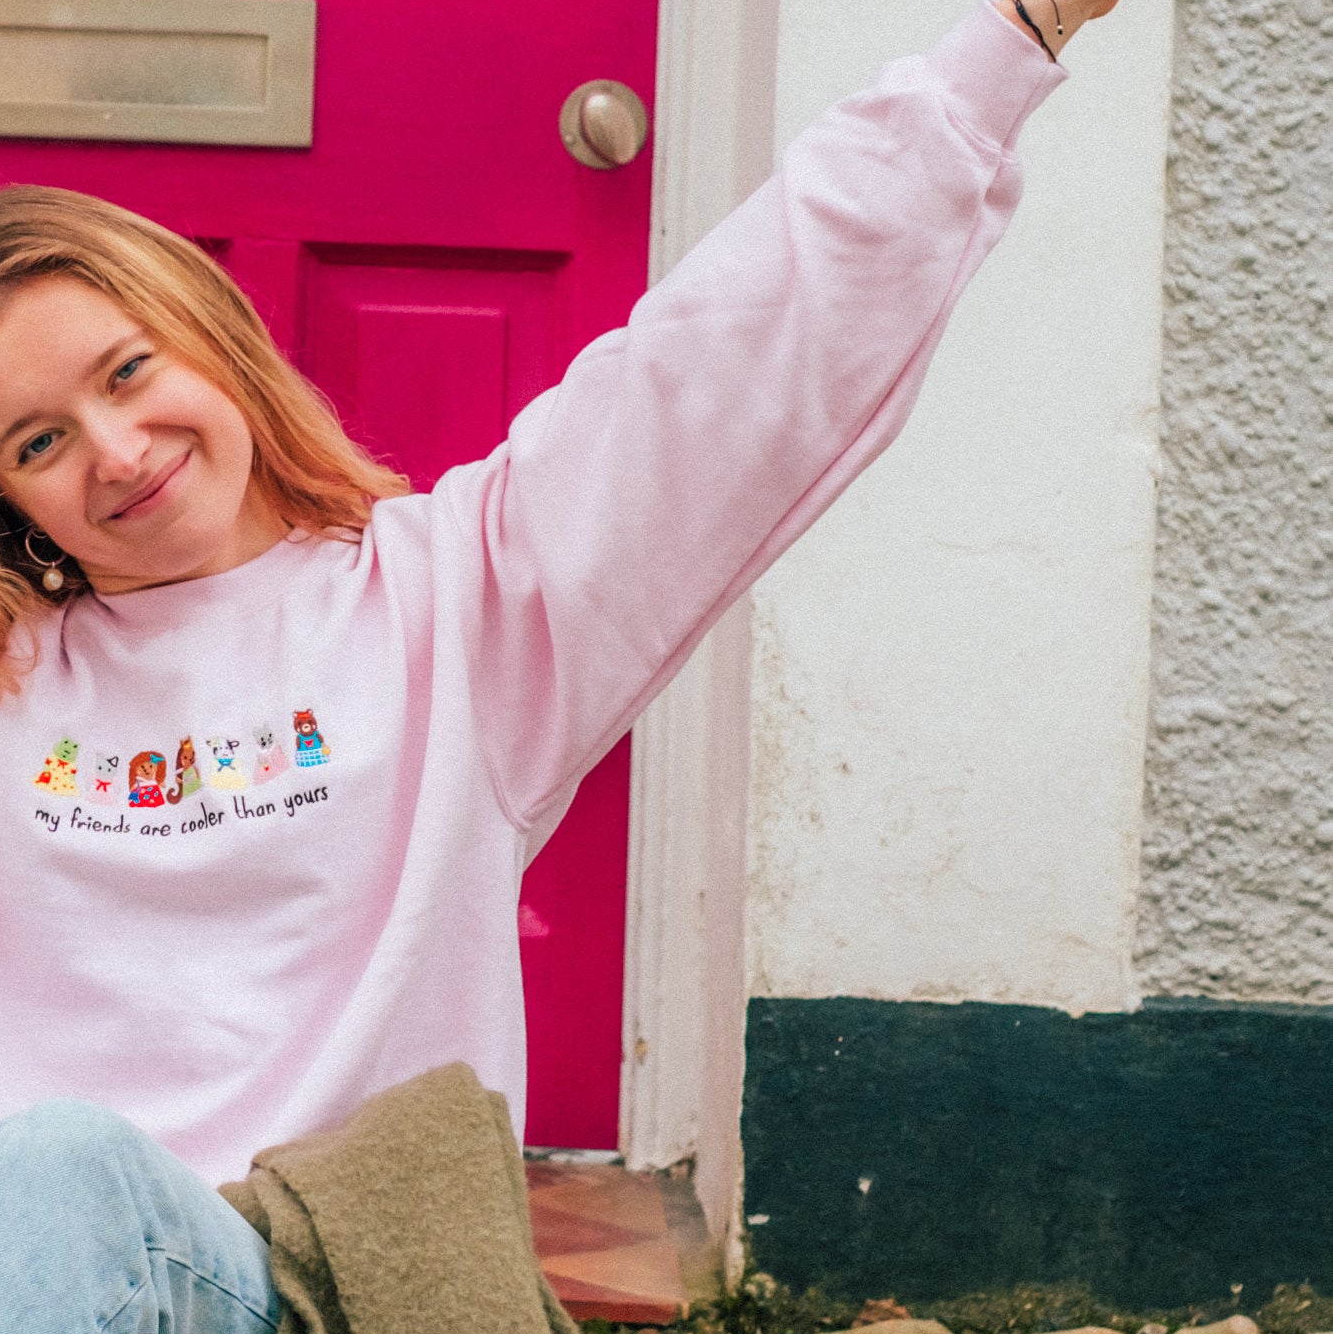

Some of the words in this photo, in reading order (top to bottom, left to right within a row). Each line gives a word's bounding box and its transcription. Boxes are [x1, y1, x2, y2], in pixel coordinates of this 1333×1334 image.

[35, 807, 60, 833] my
[71, 806, 131, 835] friends
[140, 821, 172, 837] are
[180, 801, 225, 834] cooler
[233, 795, 276, 820] than
[283, 784, 329, 817] yours
